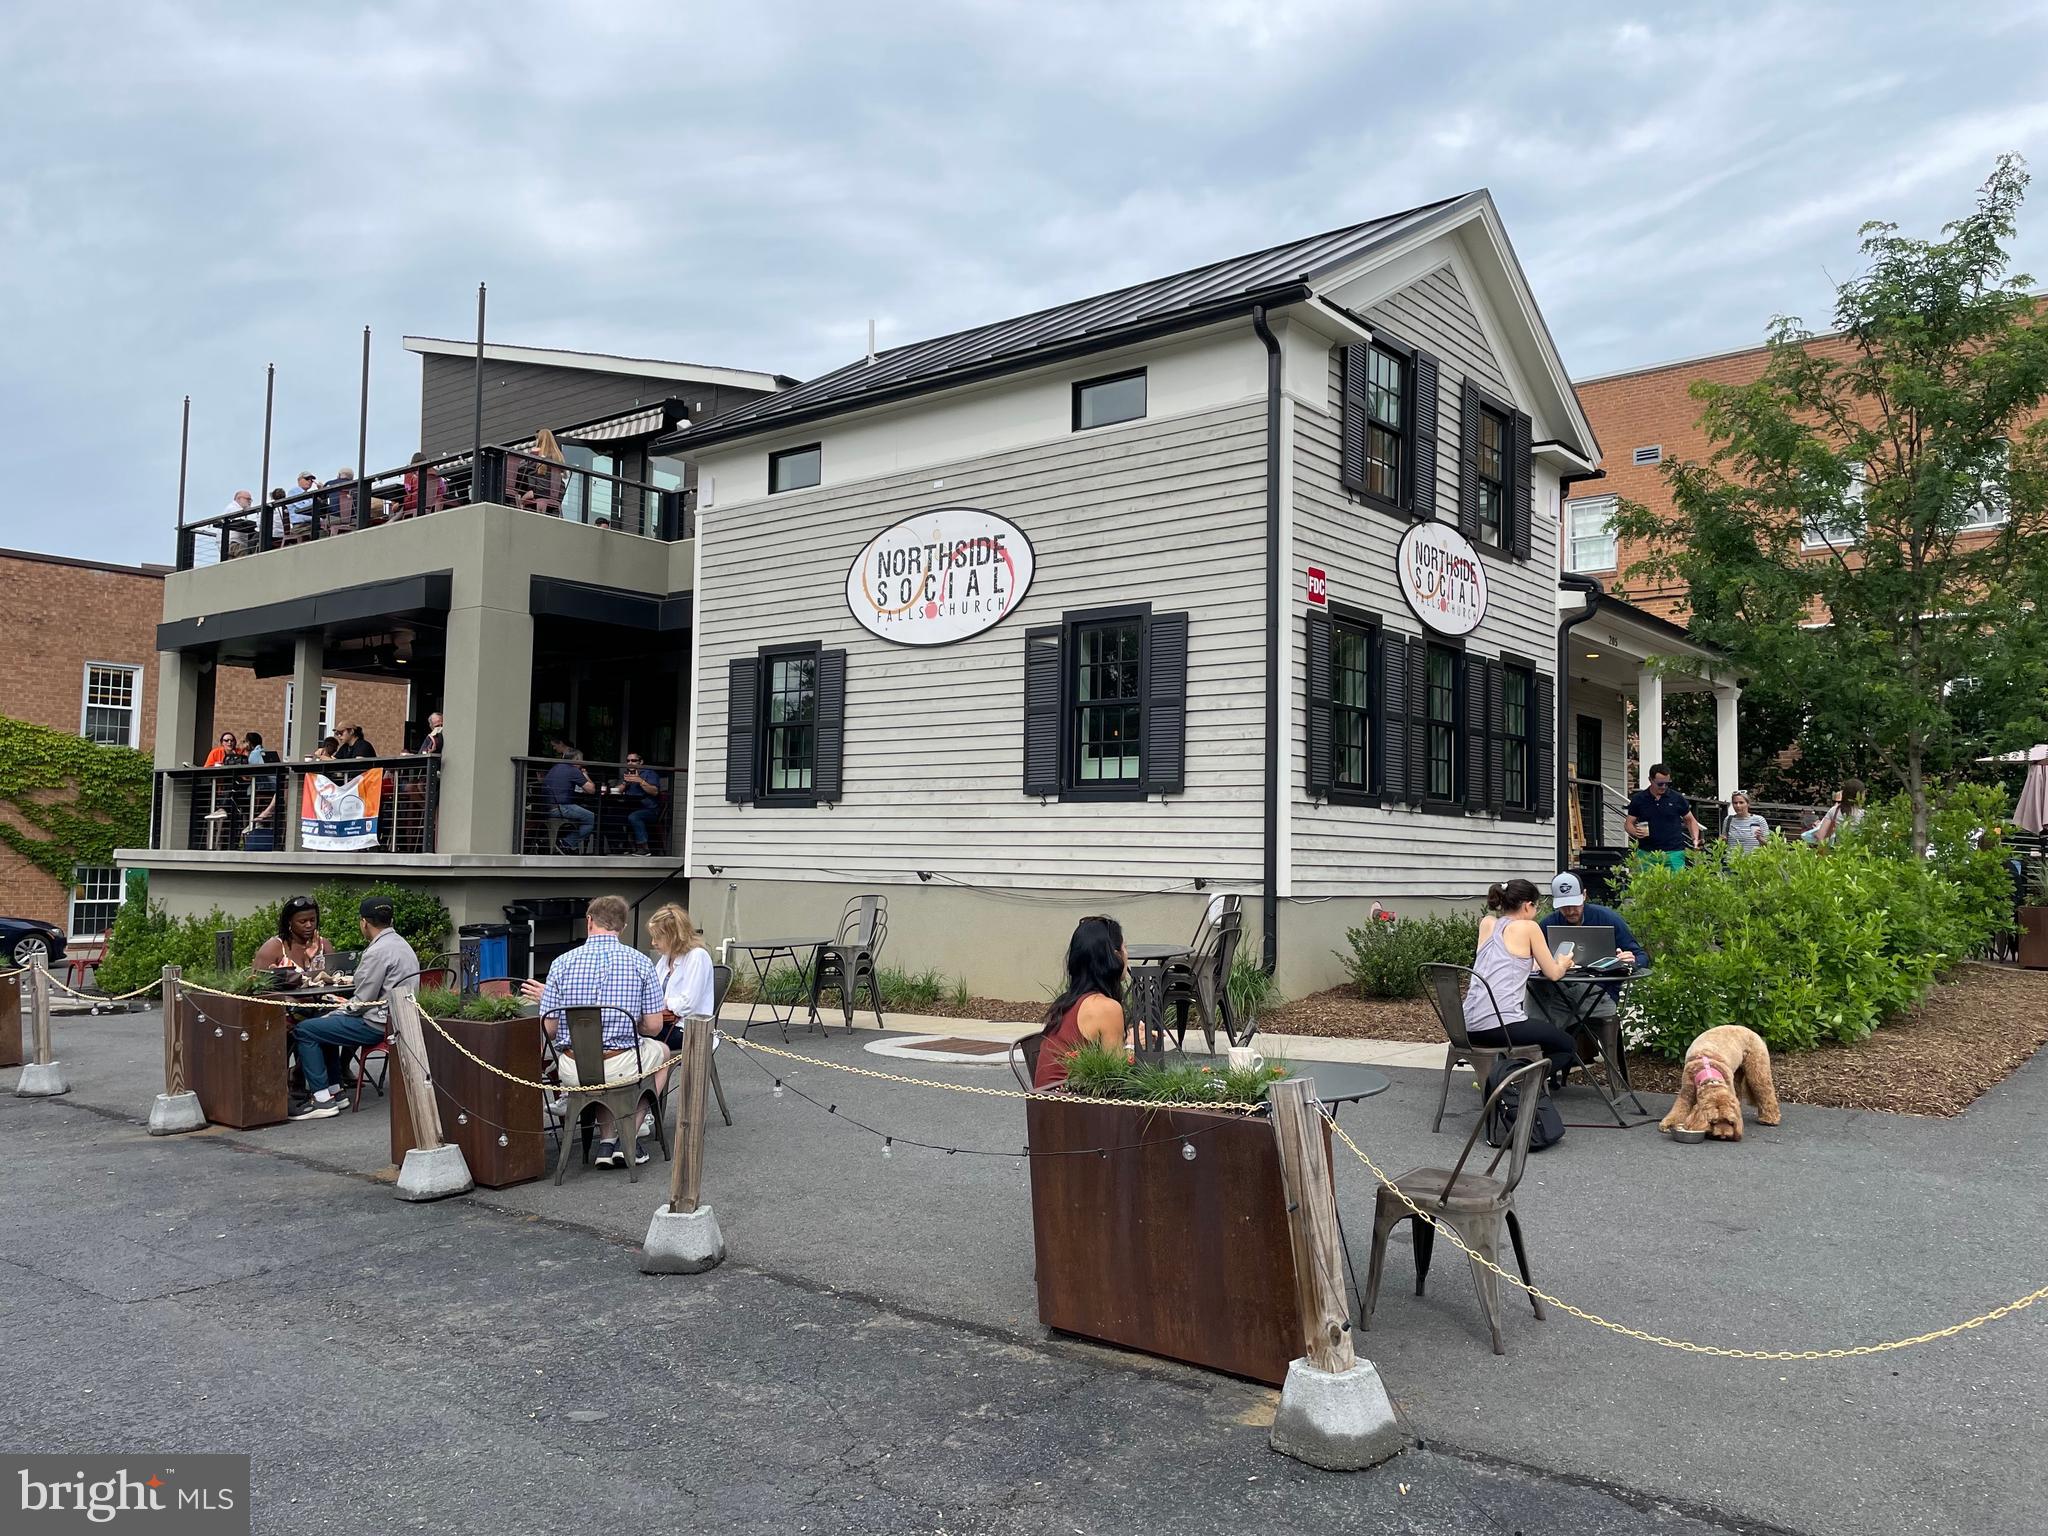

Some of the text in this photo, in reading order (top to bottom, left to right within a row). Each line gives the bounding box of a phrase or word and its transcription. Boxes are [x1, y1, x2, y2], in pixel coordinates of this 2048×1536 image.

[877, 534, 1006, 579] NORTHSIDE
[1415, 540, 1477, 584] NORTHSIDE
[877, 566, 1005, 607] SOCIAL
[1309, 575, 1325, 596] FDC
[1415, 566, 1476, 608] SOCIAL
[877, 597, 1005, 623] FALLS CHURCH
[1447, 600, 1477, 620] CHURCH
